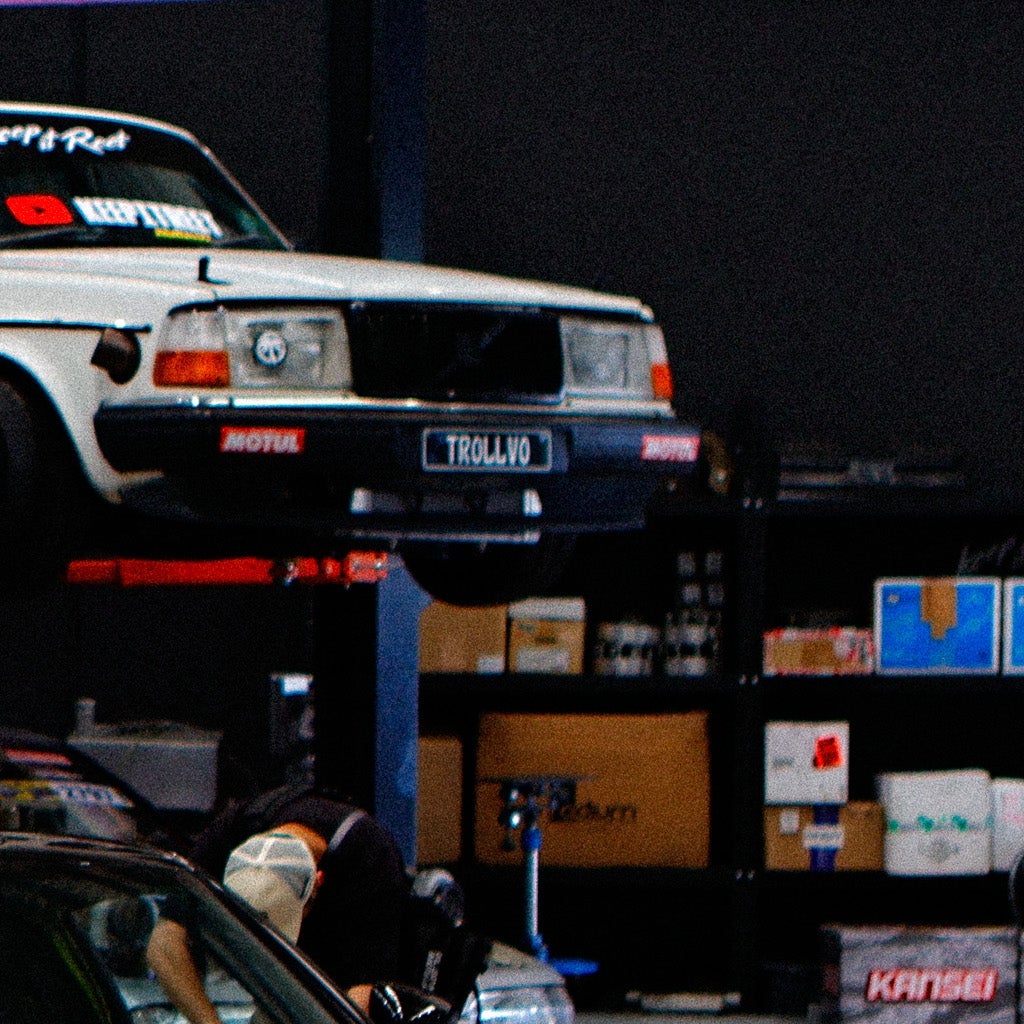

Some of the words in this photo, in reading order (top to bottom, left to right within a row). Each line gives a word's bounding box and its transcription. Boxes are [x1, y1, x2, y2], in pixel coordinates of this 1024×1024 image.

[224, 432, 299, 453] MOTUL
[446, 435, 531, 465] TROLLVO
[867, 968, 998, 1001] KANSEI
